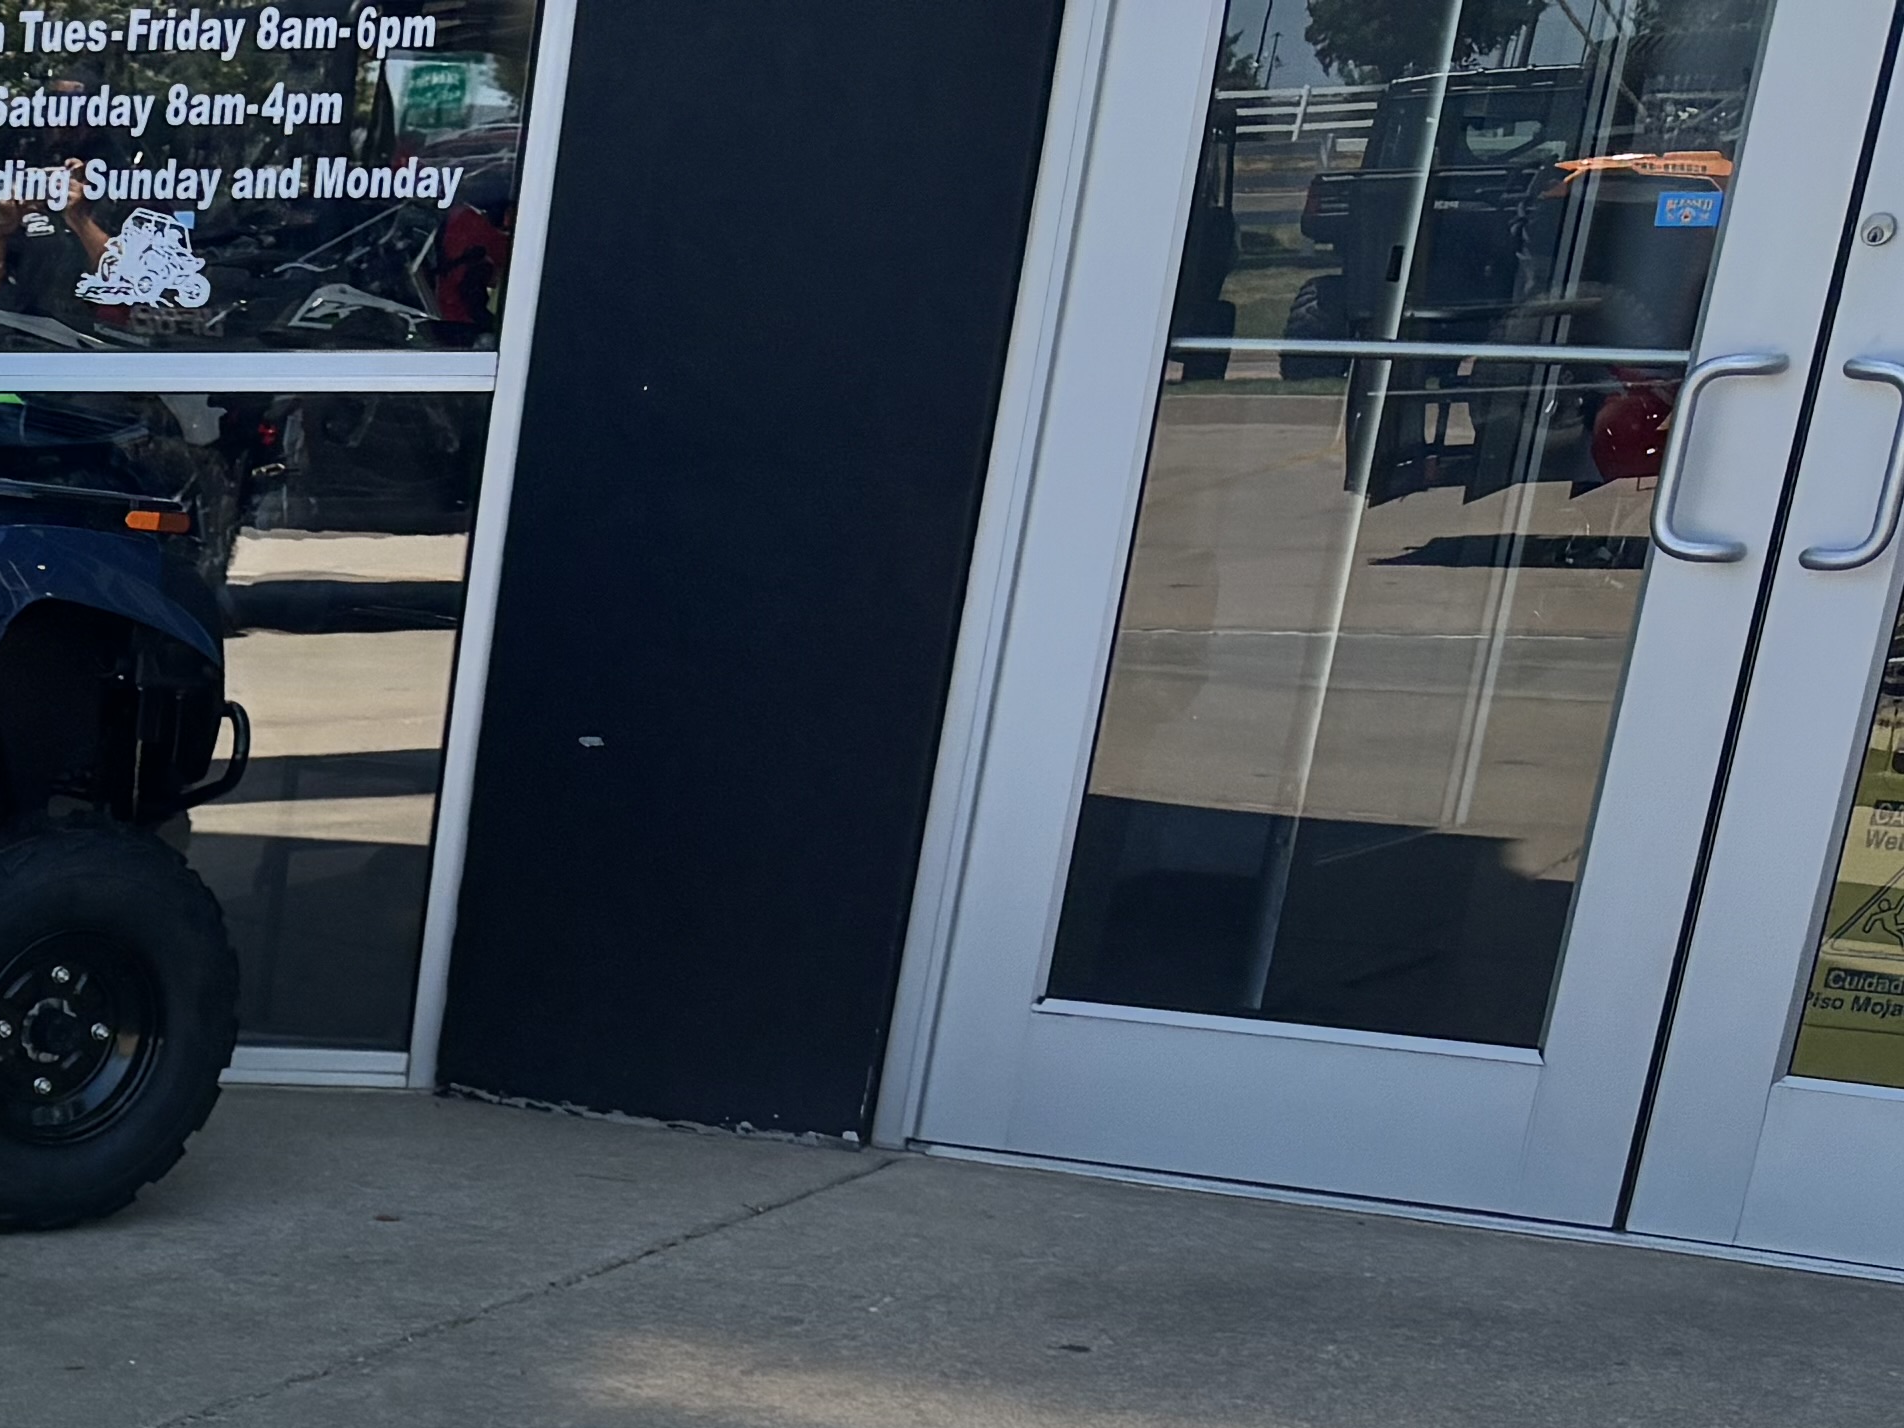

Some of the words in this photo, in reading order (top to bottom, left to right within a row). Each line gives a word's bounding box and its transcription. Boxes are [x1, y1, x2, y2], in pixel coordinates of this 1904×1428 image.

[20, 9, 245, 61] Tues-Friday
[257, 6, 436, 58] 8am-6pm
[166, 82, 342, 134] 8am-4pm
[83, 158, 221, 210] Sunday
[232, 158, 301, 199] and
[314, 157, 463, 208] Monday
